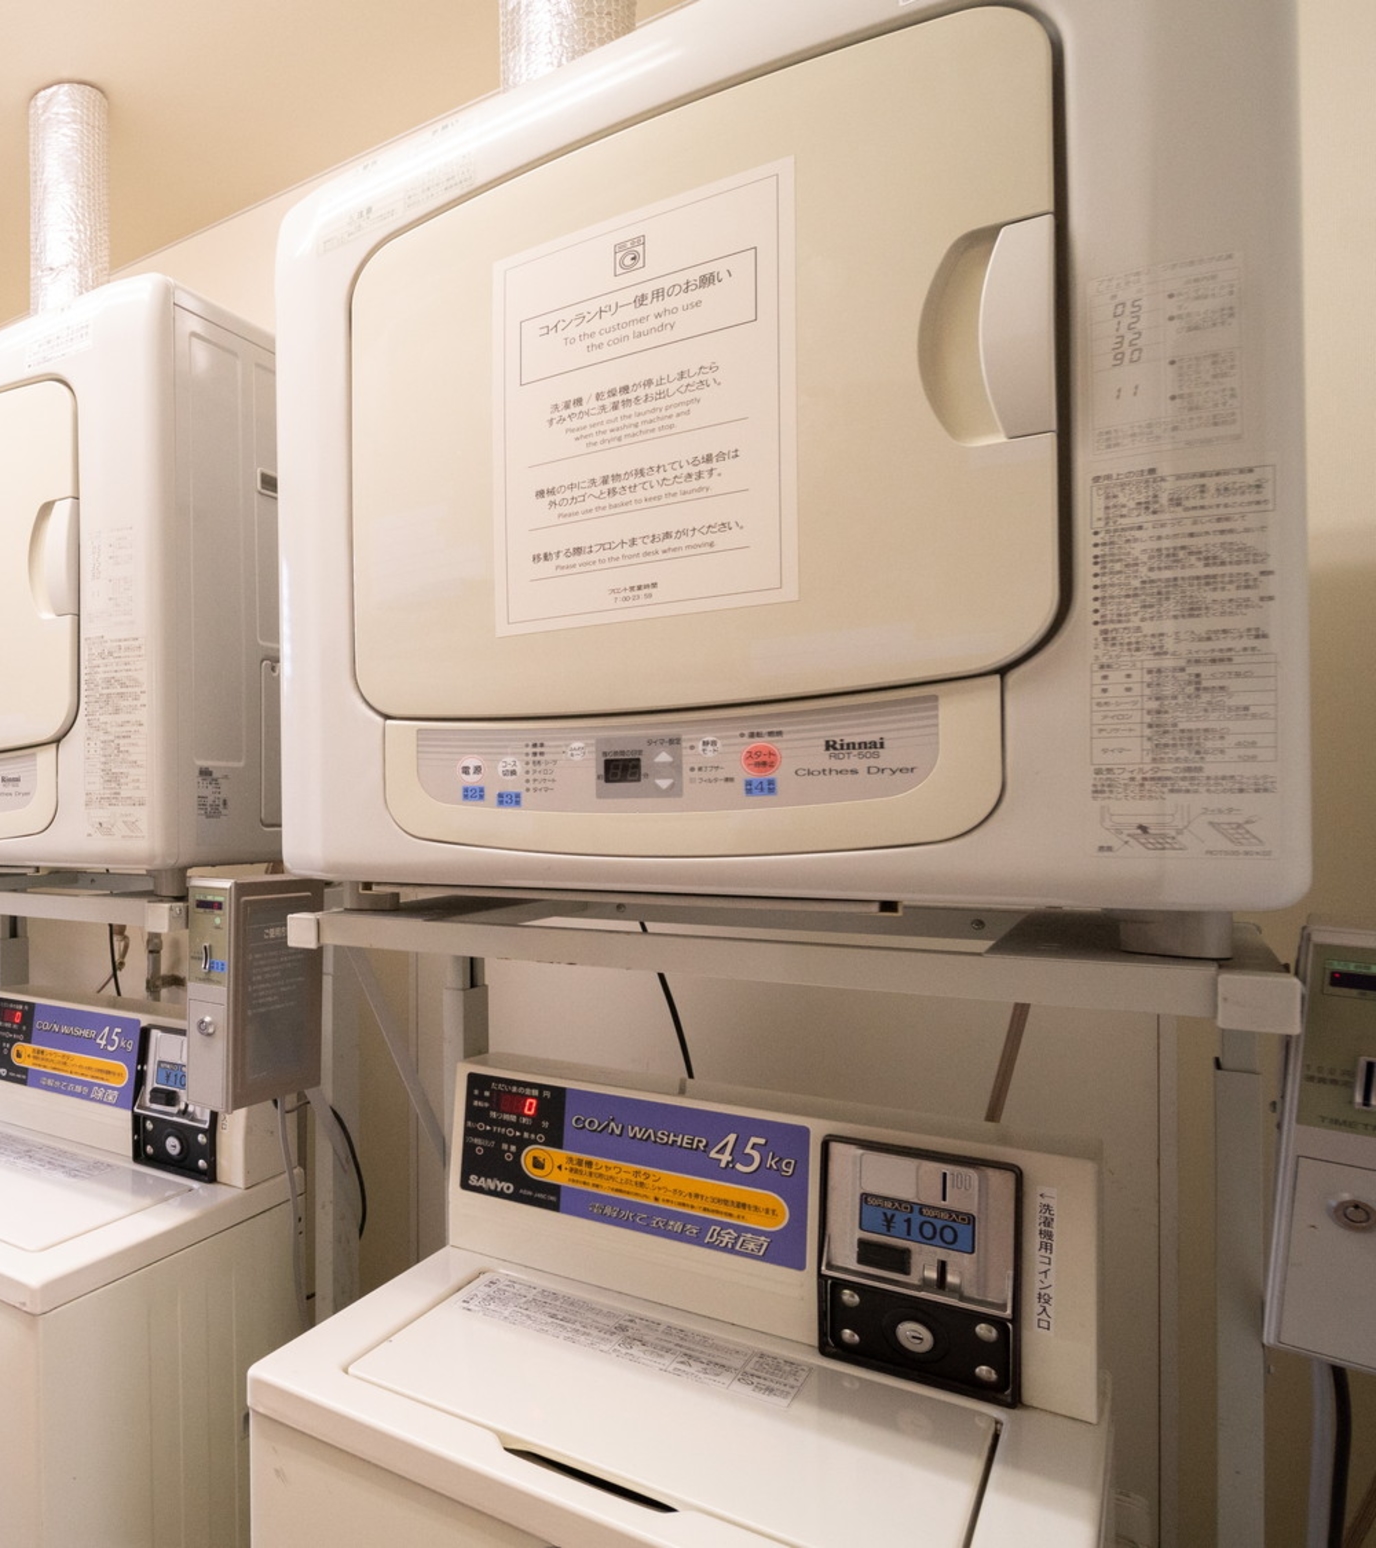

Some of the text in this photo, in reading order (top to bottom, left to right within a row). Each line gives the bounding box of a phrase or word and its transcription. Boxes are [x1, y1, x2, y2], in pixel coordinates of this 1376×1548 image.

[538, 269, 733, 337] コインランドリー使用のお願い
[563, 299, 703, 347] To the customer who use
[586, 321, 677, 353] the coin laundry
[550, 396, 584, 414] 洗濯機
[565, 397, 701, 435] Please sent out the laundry promptly
[574, 408, 691, 442] when the washing machine and
[585, 439, 598, 448] the
[599, 433, 623, 447] drying
[624, 427, 656, 439] machine
[534, 448, 740, 500] 機械の中に洗濯物が残されている場合は
[557, 510, 579, 520] Please
[580, 507, 594, 516] use
[594, 504, 607, 513] the
[608, 499, 633, 511] basket
[644, 493, 662, 505] keep
[664, 489, 678, 499] the
[555, 562, 577, 572] Please
[578, 559, 597, 569] voice
[608, 554, 620, 564] the
[621, 551, 640, 561] front
[642, 548, 660, 558] desk
[662, 545, 683, 555] when
[745, 750, 777, 760] スタート
[824, 737, 885, 751] Rinnai
[829, 751, 881, 760] RDT-50S
[461, 765, 483, 776] 電源
[794, 764, 918, 777] Clothes Dryer
[14, 1011, 22, 1024] 0
[60, 1024, 97, 1040] WASHER
[524, 1098, 537, 1115] 0
[627, 1122, 707, 1152] WASHER
[565, 1154, 662, 1183] 洗濯槽シャワーボタン
[468, 1174, 514, 1194] SANYO
[704, 1224, 773, 1257] 除菌
[881, 1211, 959, 1246] ¥100
[1036, 1201, 1056, 1332] 洗濯機用コイン投入口
